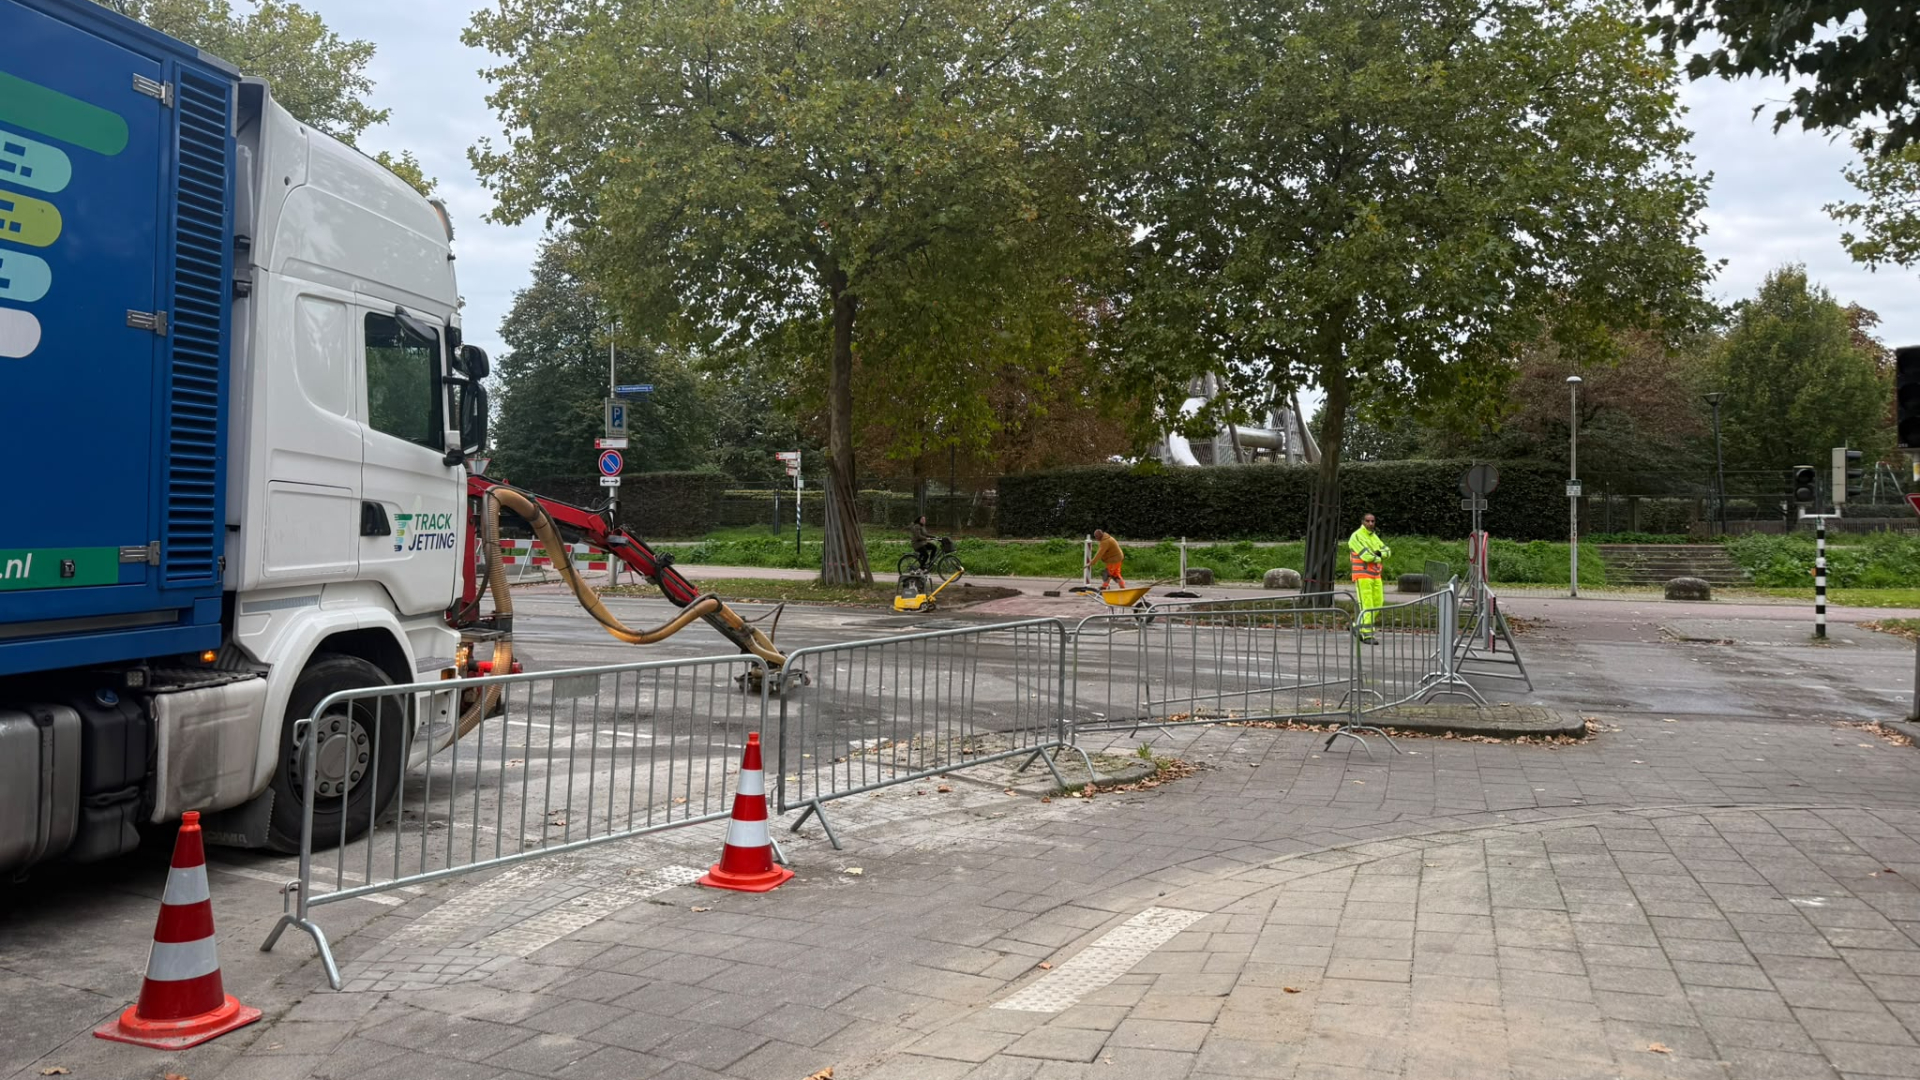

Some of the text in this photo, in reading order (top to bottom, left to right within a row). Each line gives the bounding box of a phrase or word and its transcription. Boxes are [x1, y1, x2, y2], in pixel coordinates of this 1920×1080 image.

[614, 407, 621, 419] P
[415, 513, 452, 530] TRACK
[408, 532, 455, 551] JETTING
